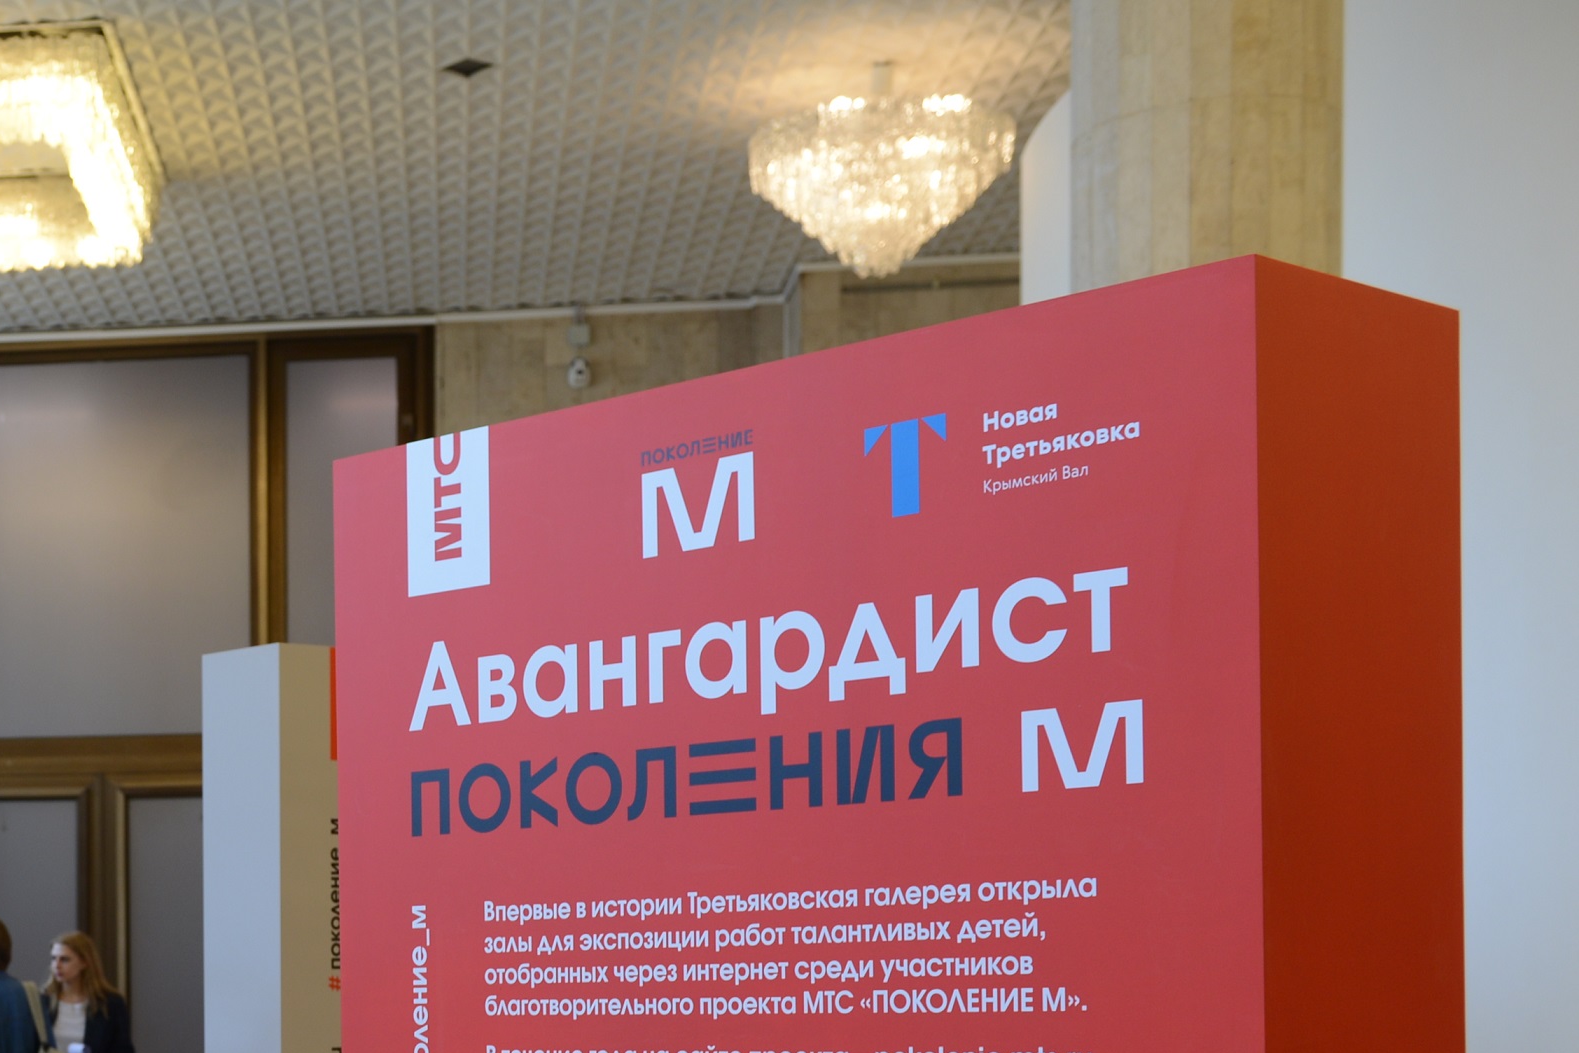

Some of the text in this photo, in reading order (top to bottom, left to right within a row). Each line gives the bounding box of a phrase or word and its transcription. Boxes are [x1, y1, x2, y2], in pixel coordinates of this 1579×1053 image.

[982, 402, 1059, 433] Новая
[640, 428, 754, 467] ПОКОЛЕНИЕ
[981, 420, 1141, 469] Третьяковка
[982, 464, 1090, 496] Крымский Вал
[640, 450, 756, 560] М
[408, 565, 1129, 733] Авангардист
[409, 698, 1145, 838] ПОКОЛЕНИЯ М
[483, 877, 1097, 926] Впервые в истории Третьяковская галерея открыла
[483, 911, 1046, 956] залы для экспозиции работ талантливых детей,
[484, 955, 1034, 989] отобранных через интернет среди участников
[484, 986, 1088, 1021] благотворительного проекта МТС «ПОКОЛЕНИЕ М».
